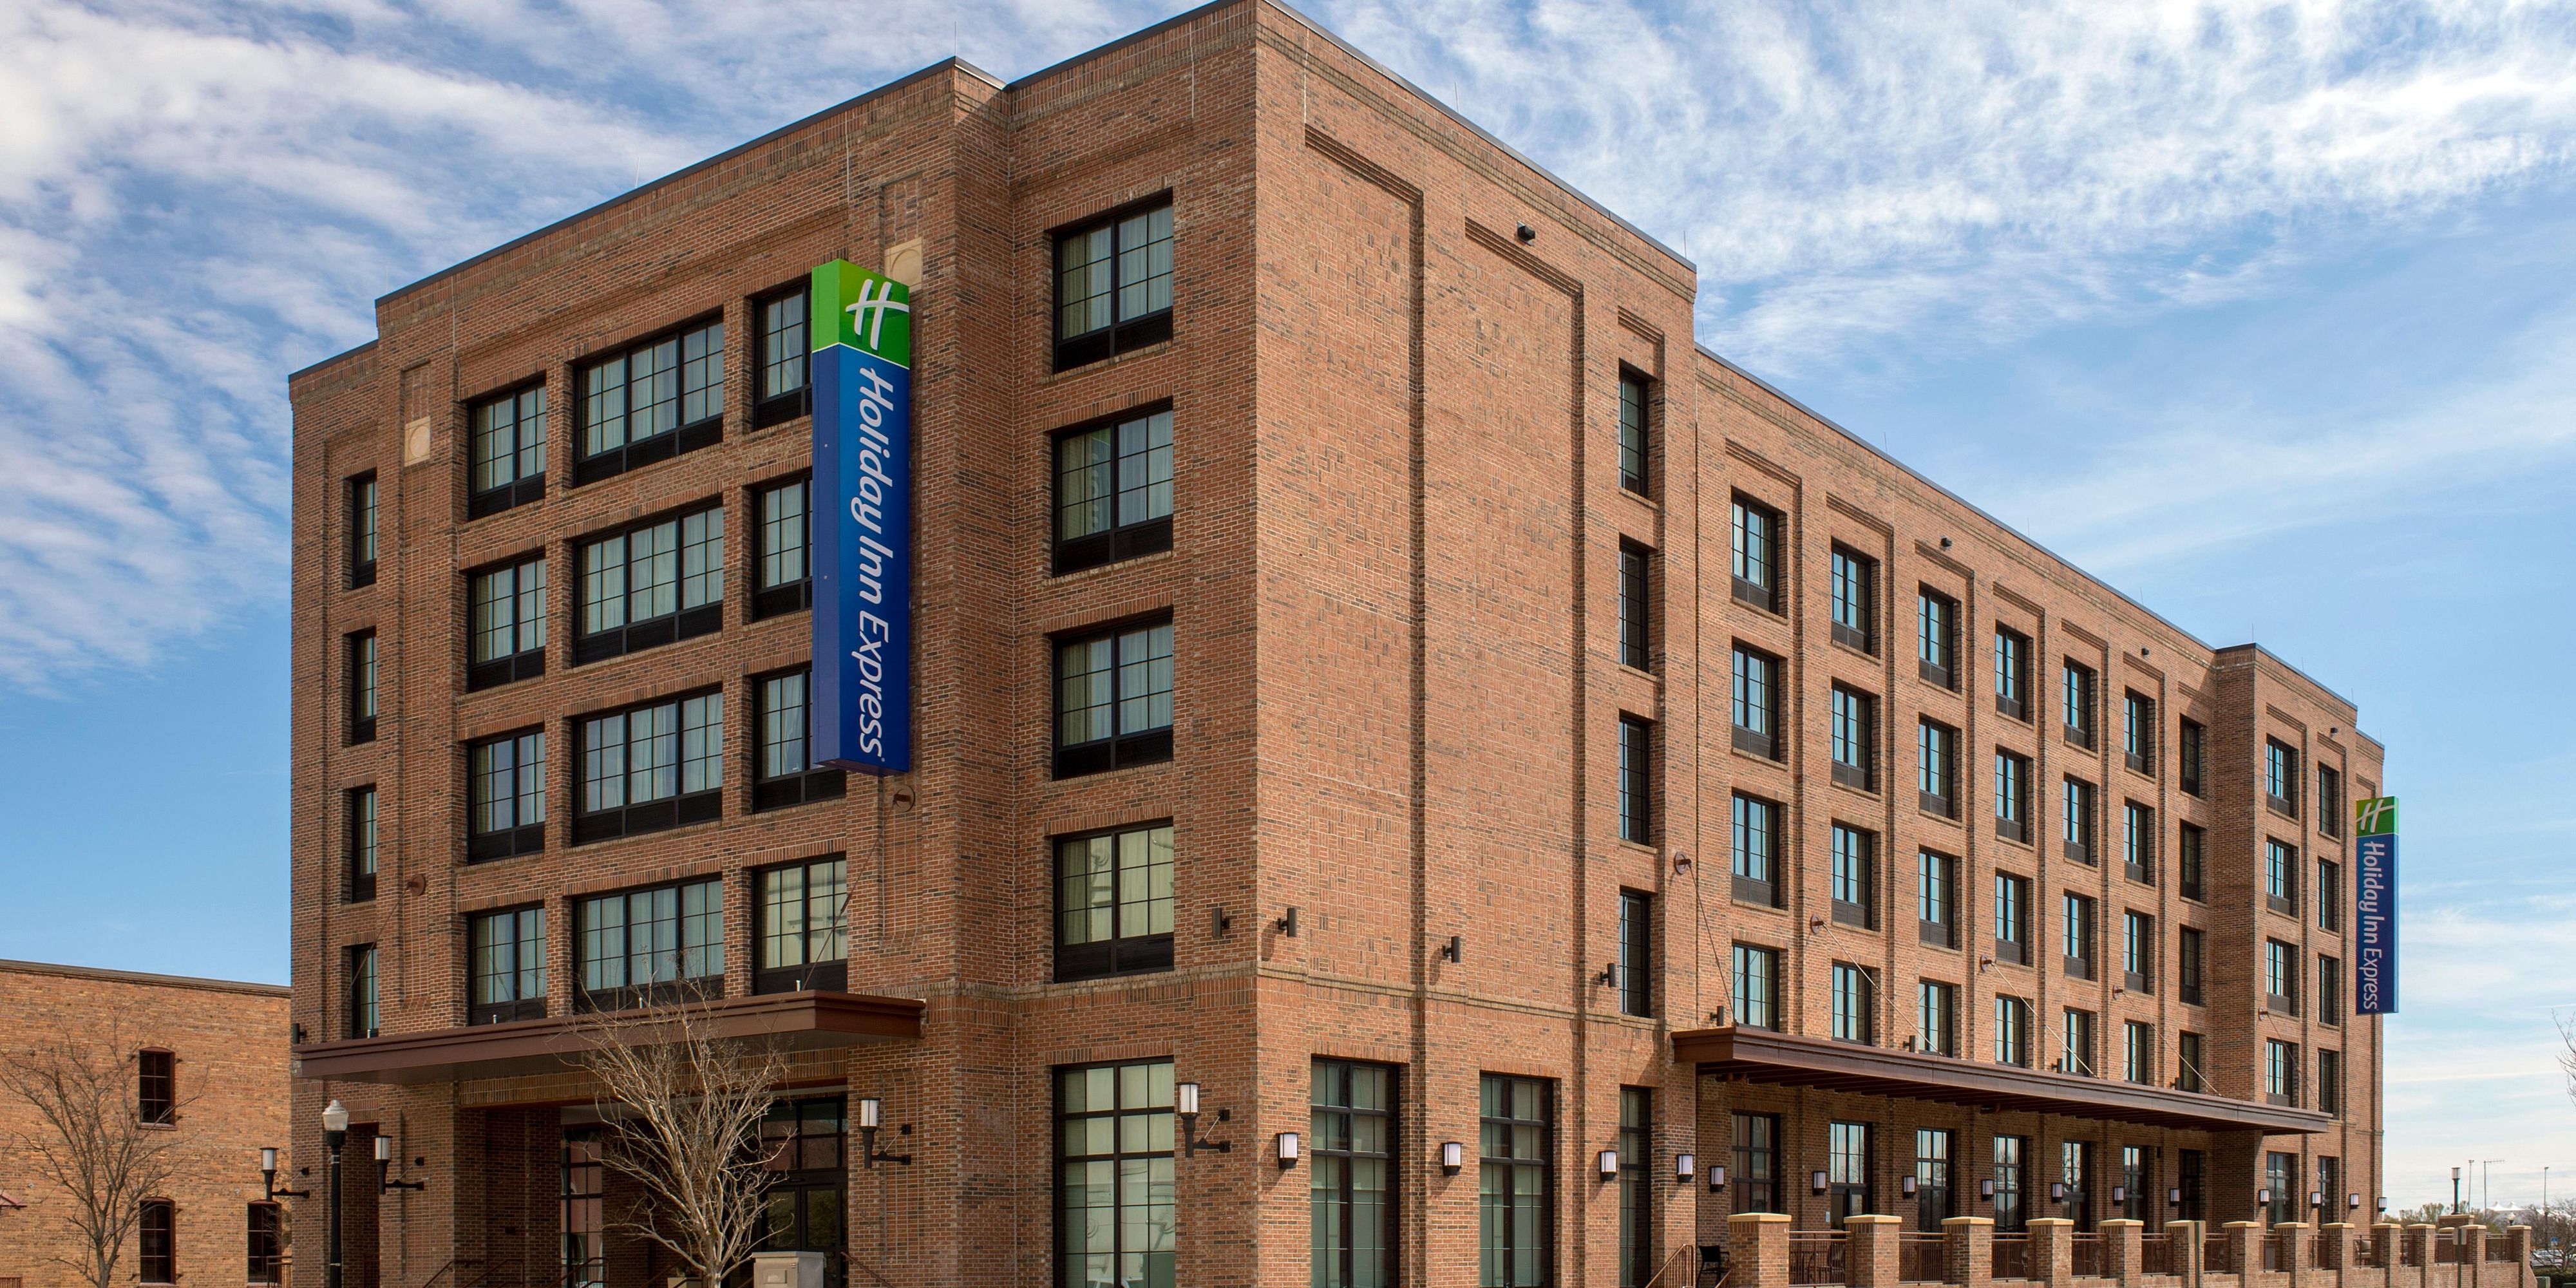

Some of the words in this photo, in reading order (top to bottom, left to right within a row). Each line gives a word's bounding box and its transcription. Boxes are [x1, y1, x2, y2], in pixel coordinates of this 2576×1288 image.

[851, 368, 894, 535] Holiday
[859, 535, 893, 604] Inn
[852, 610, 889, 757] Express
[2359, 841, 2385, 912] Holiday
[2363, 916, 2385, 943] Inn
[2359, 947, 2382, 1010] Express
